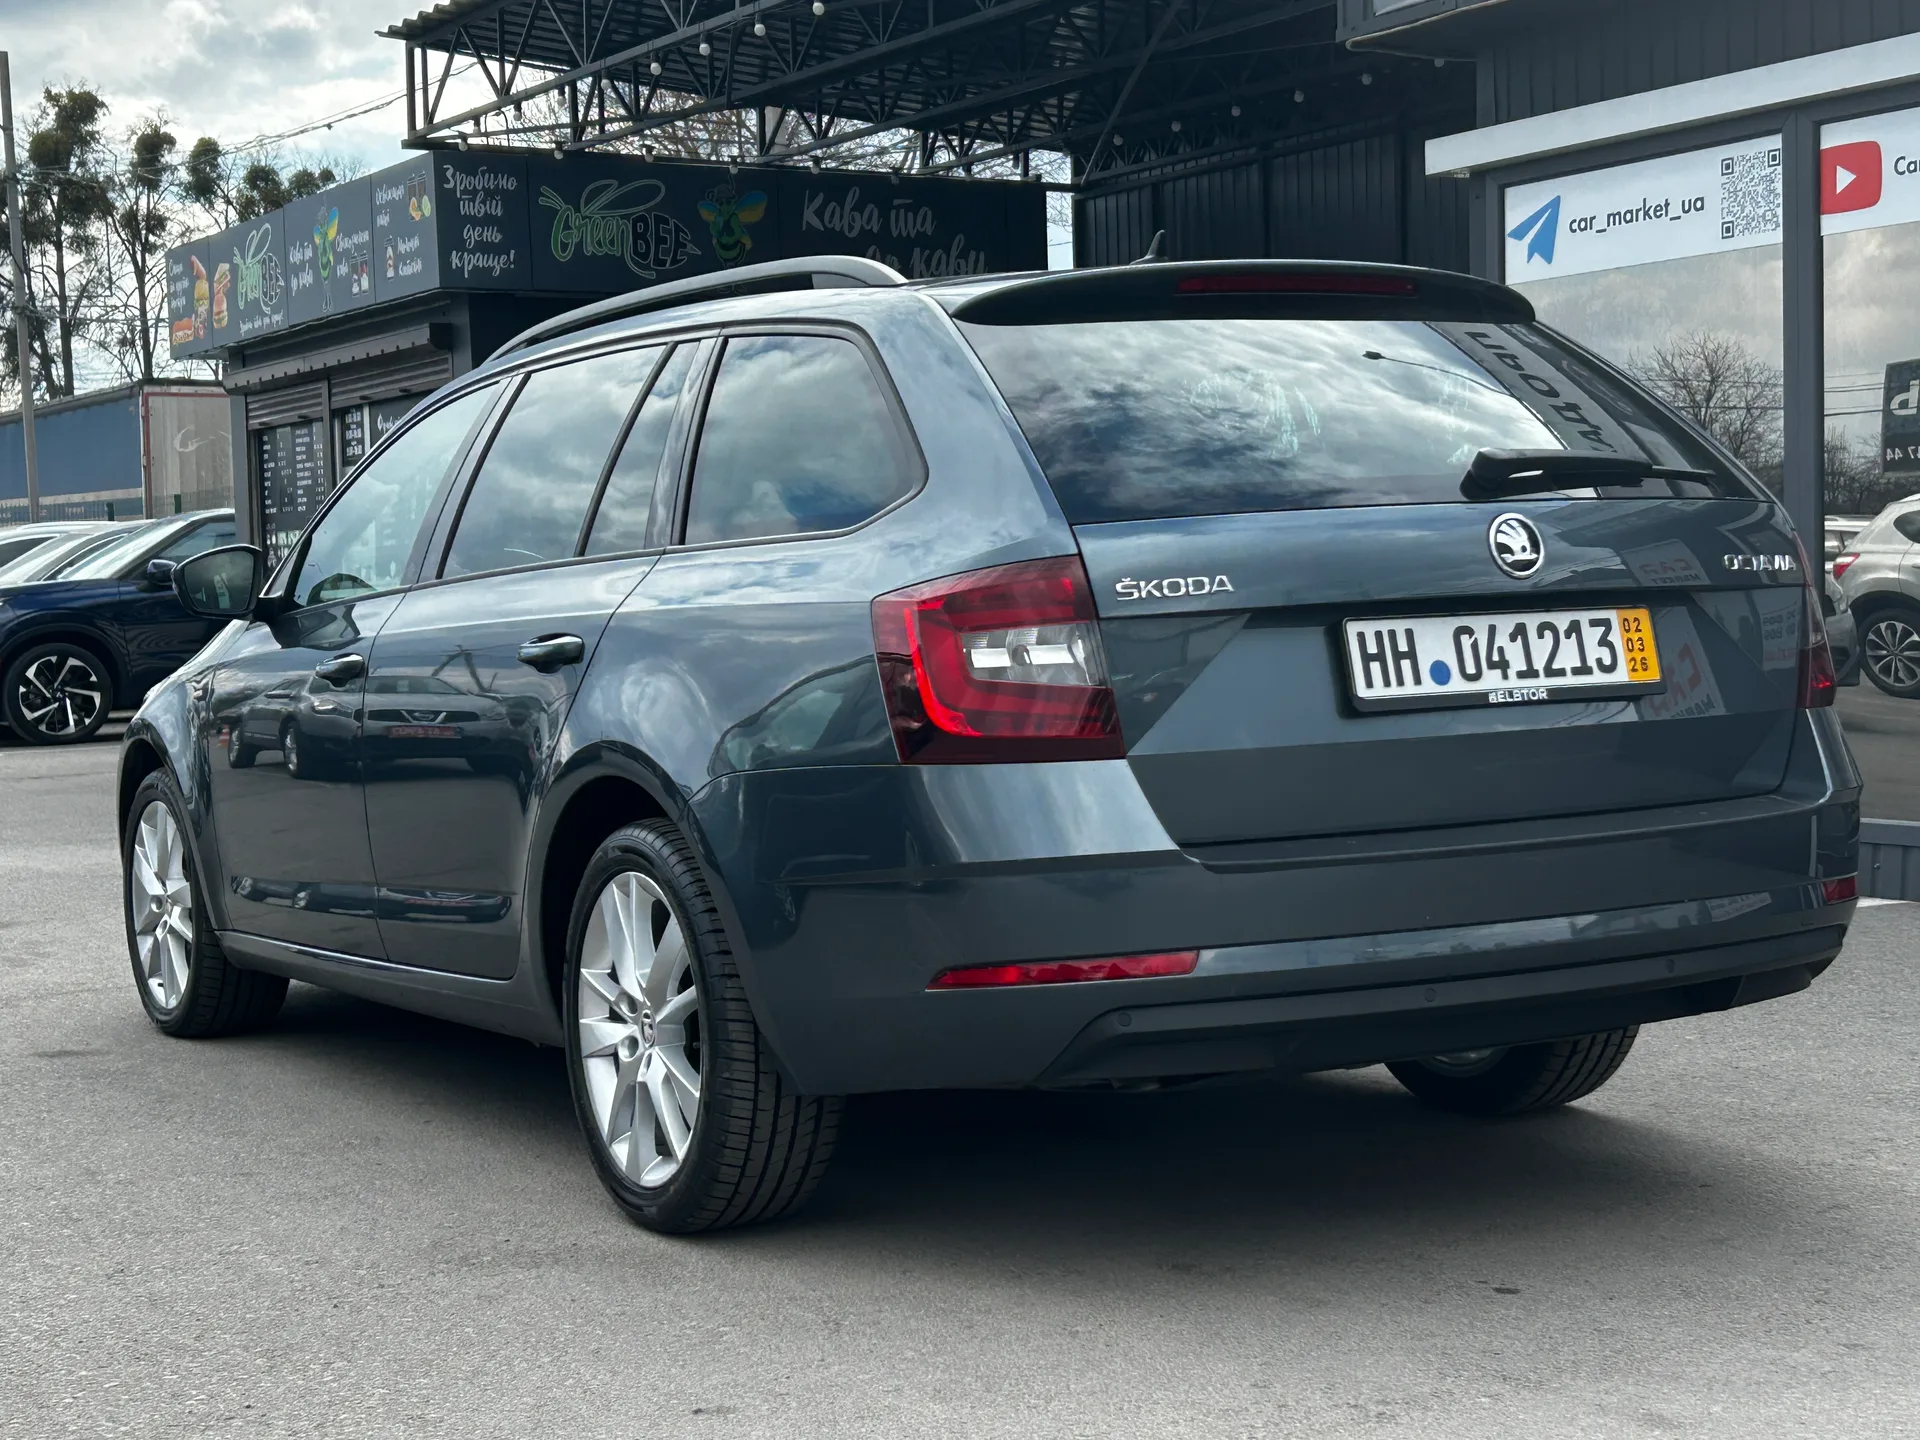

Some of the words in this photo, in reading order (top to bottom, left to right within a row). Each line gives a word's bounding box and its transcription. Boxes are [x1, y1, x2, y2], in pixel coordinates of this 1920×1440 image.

[1893, 155, 1920, 176] Ca
[443, 165, 518, 198] Зробимо
[460, 191, 504, 217] твій
[802, 186, 883, 239] Кава
[890, 198, 937, 240] та
[1569, 196, 1705, 234] car_market_ua
[463, 224, 503, 249] день
[450, 250, 516, 279] краще!
[1115, 576, 1235, 600] ŠKODA
[1622, 617, 1643, 634] 02
[1356, 628, 1422, 689] HH
[1453, 618, 1619, 682] 041213
[1626, 637, 1646, 653] 03
[1629, 656, 1649, 673] 26
